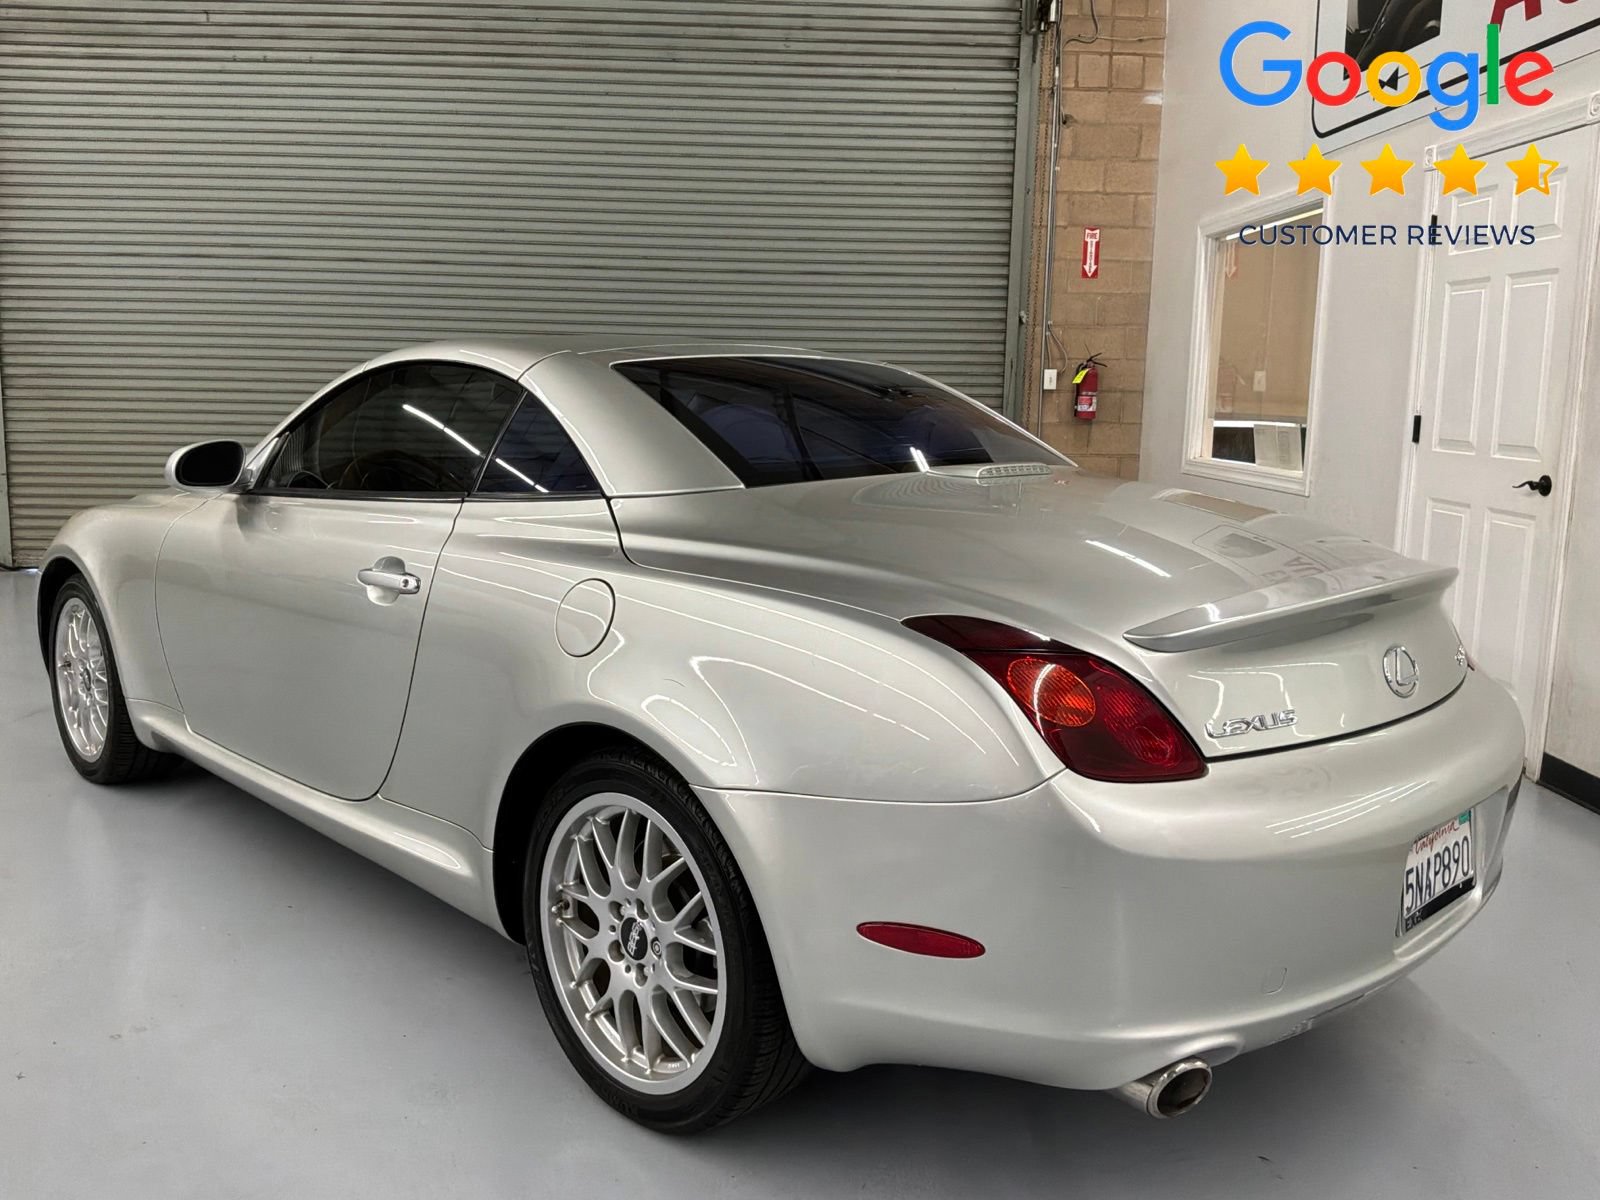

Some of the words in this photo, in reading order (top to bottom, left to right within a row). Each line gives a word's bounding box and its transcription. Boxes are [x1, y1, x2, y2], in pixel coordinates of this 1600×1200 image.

[1086, 232, 1098, 240] FIRE
[1205, 709, 1297, 739] LEXUS
[1405, 836, 1470, 911] 5NAP890
